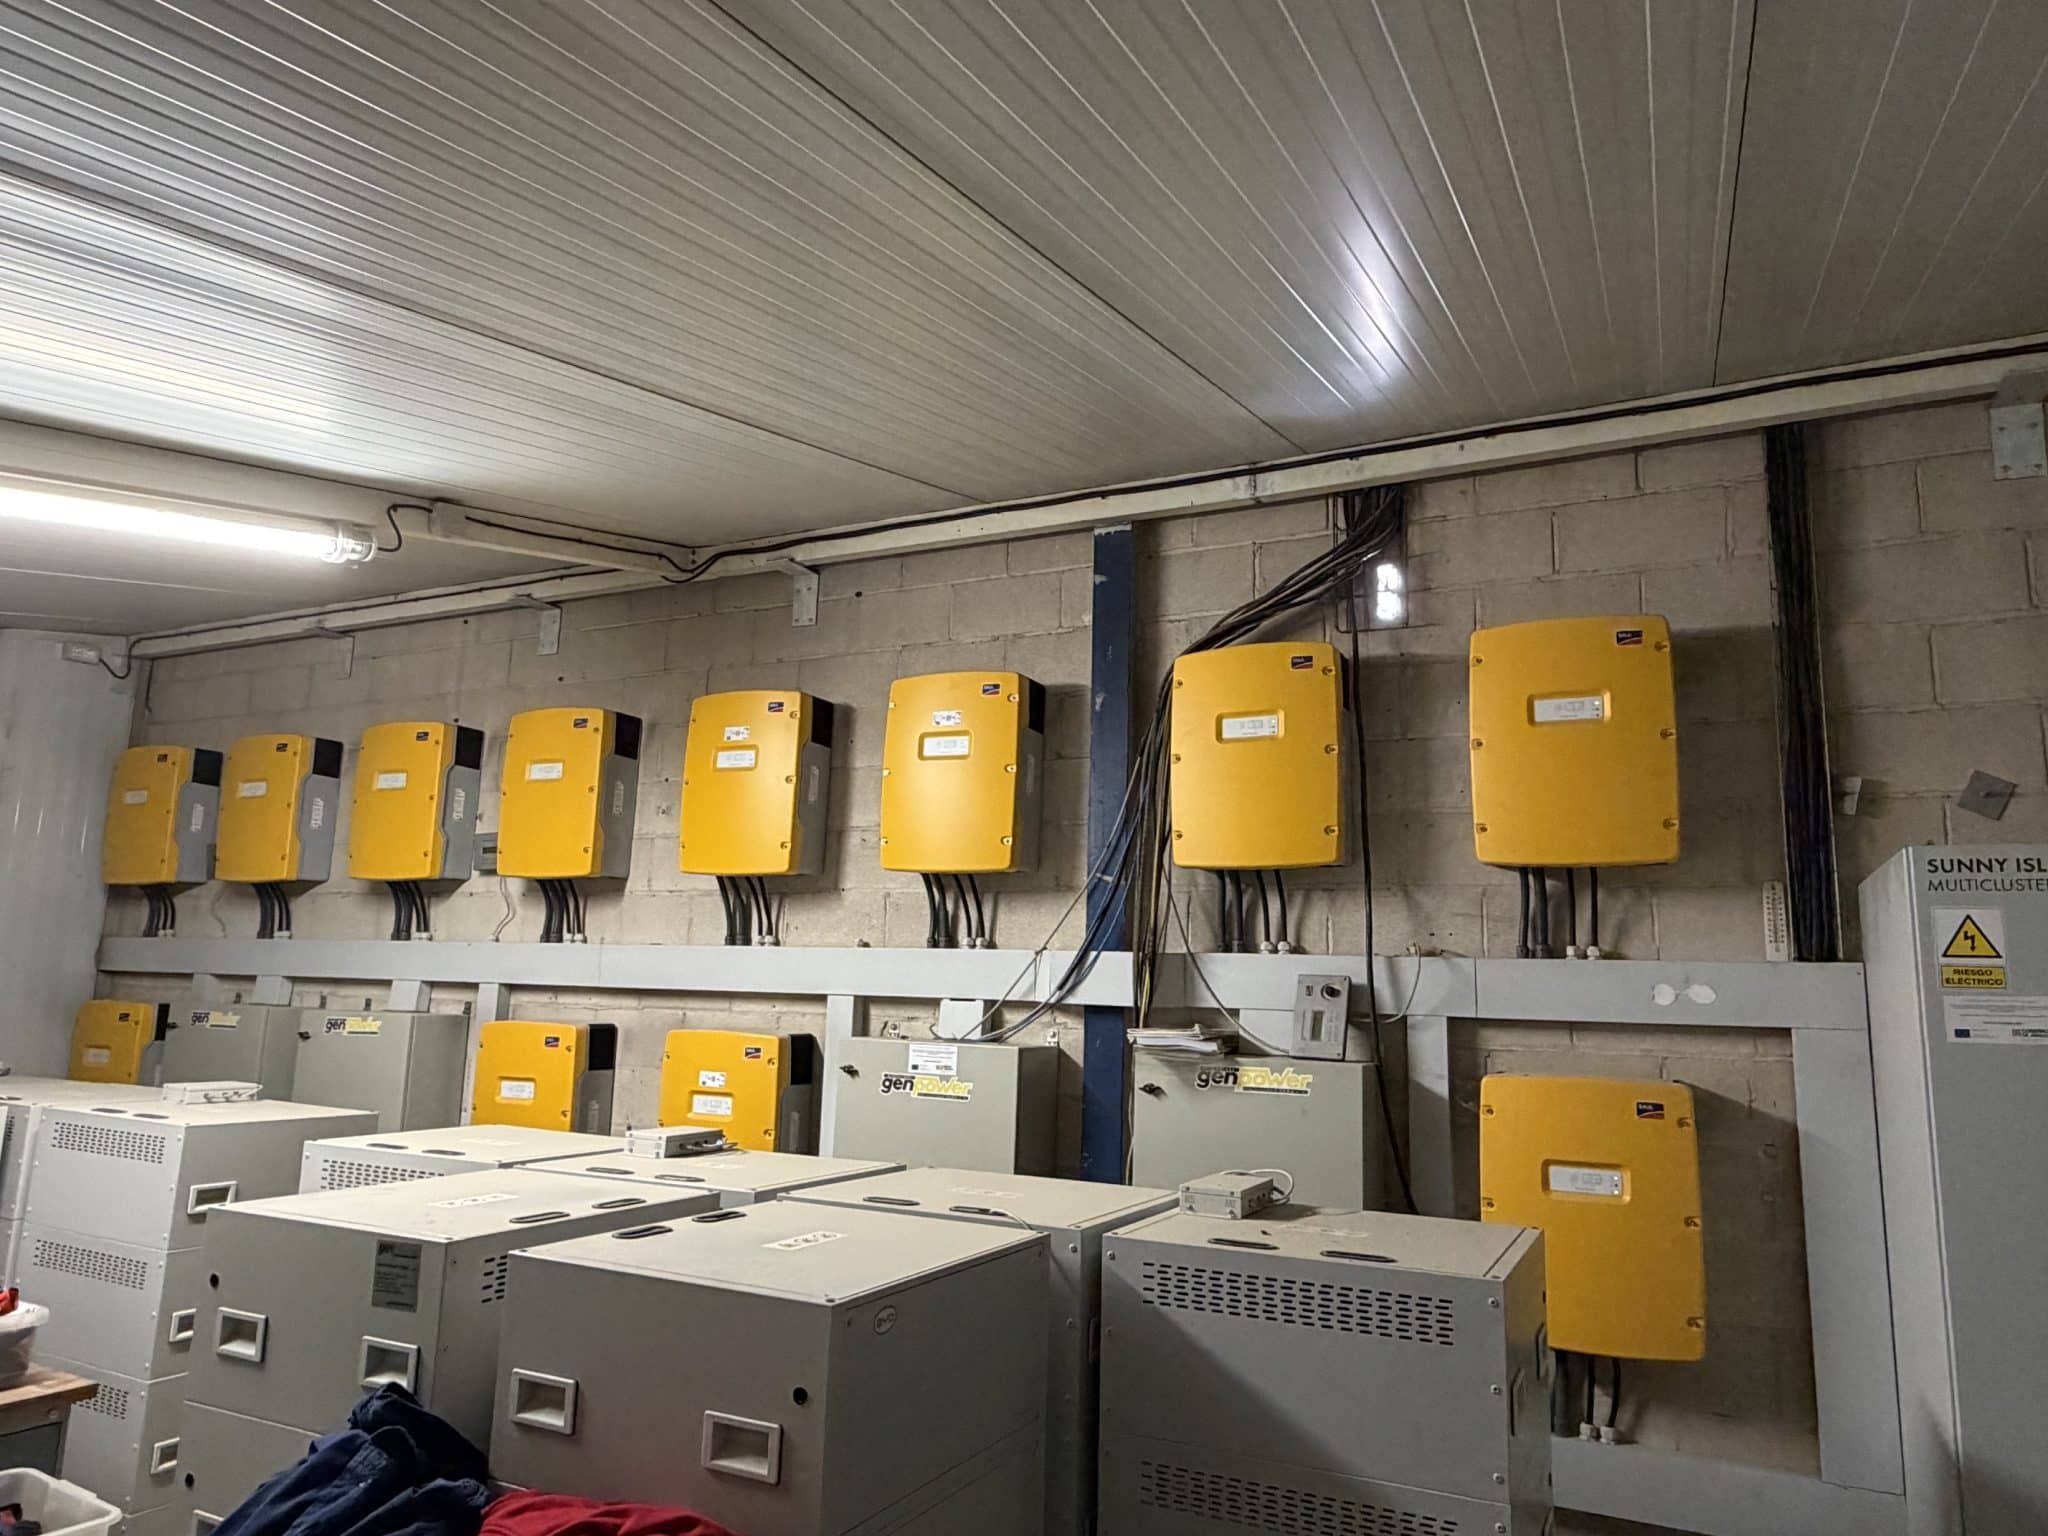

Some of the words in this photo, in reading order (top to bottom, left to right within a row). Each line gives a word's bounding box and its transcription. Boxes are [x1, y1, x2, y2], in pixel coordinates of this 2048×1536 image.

[1927, 857, 2008, 873] SUNNY
[1927, 878, 2048, 892] MULTICLUSTE
[1952, 968, 1993, 977] RIESGO
